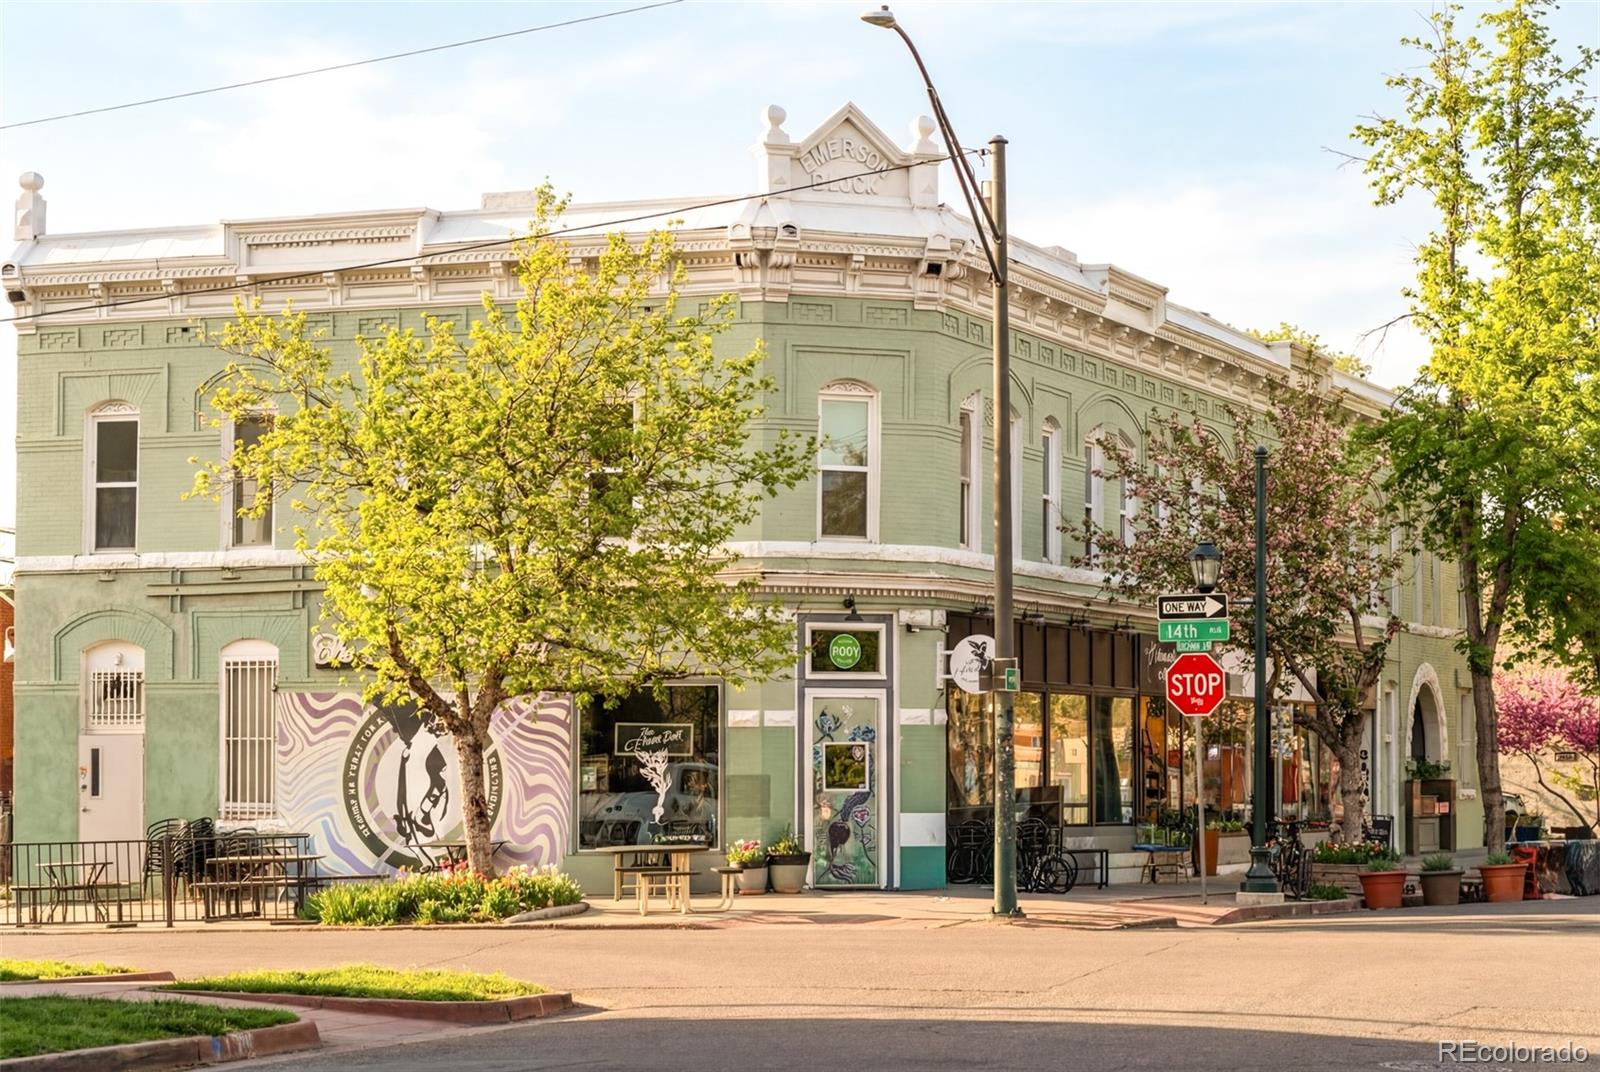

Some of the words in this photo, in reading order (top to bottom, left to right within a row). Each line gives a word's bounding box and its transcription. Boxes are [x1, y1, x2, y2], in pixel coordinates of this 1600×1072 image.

[800, 138, 891, 180] EMERSON
[1165, 602, 1184, 612] ONE
[1186, 602, 1207, 612] WAY
[1167, 624, 1198, 639] 14th
[1171, 673, 1221, 696] STOP
